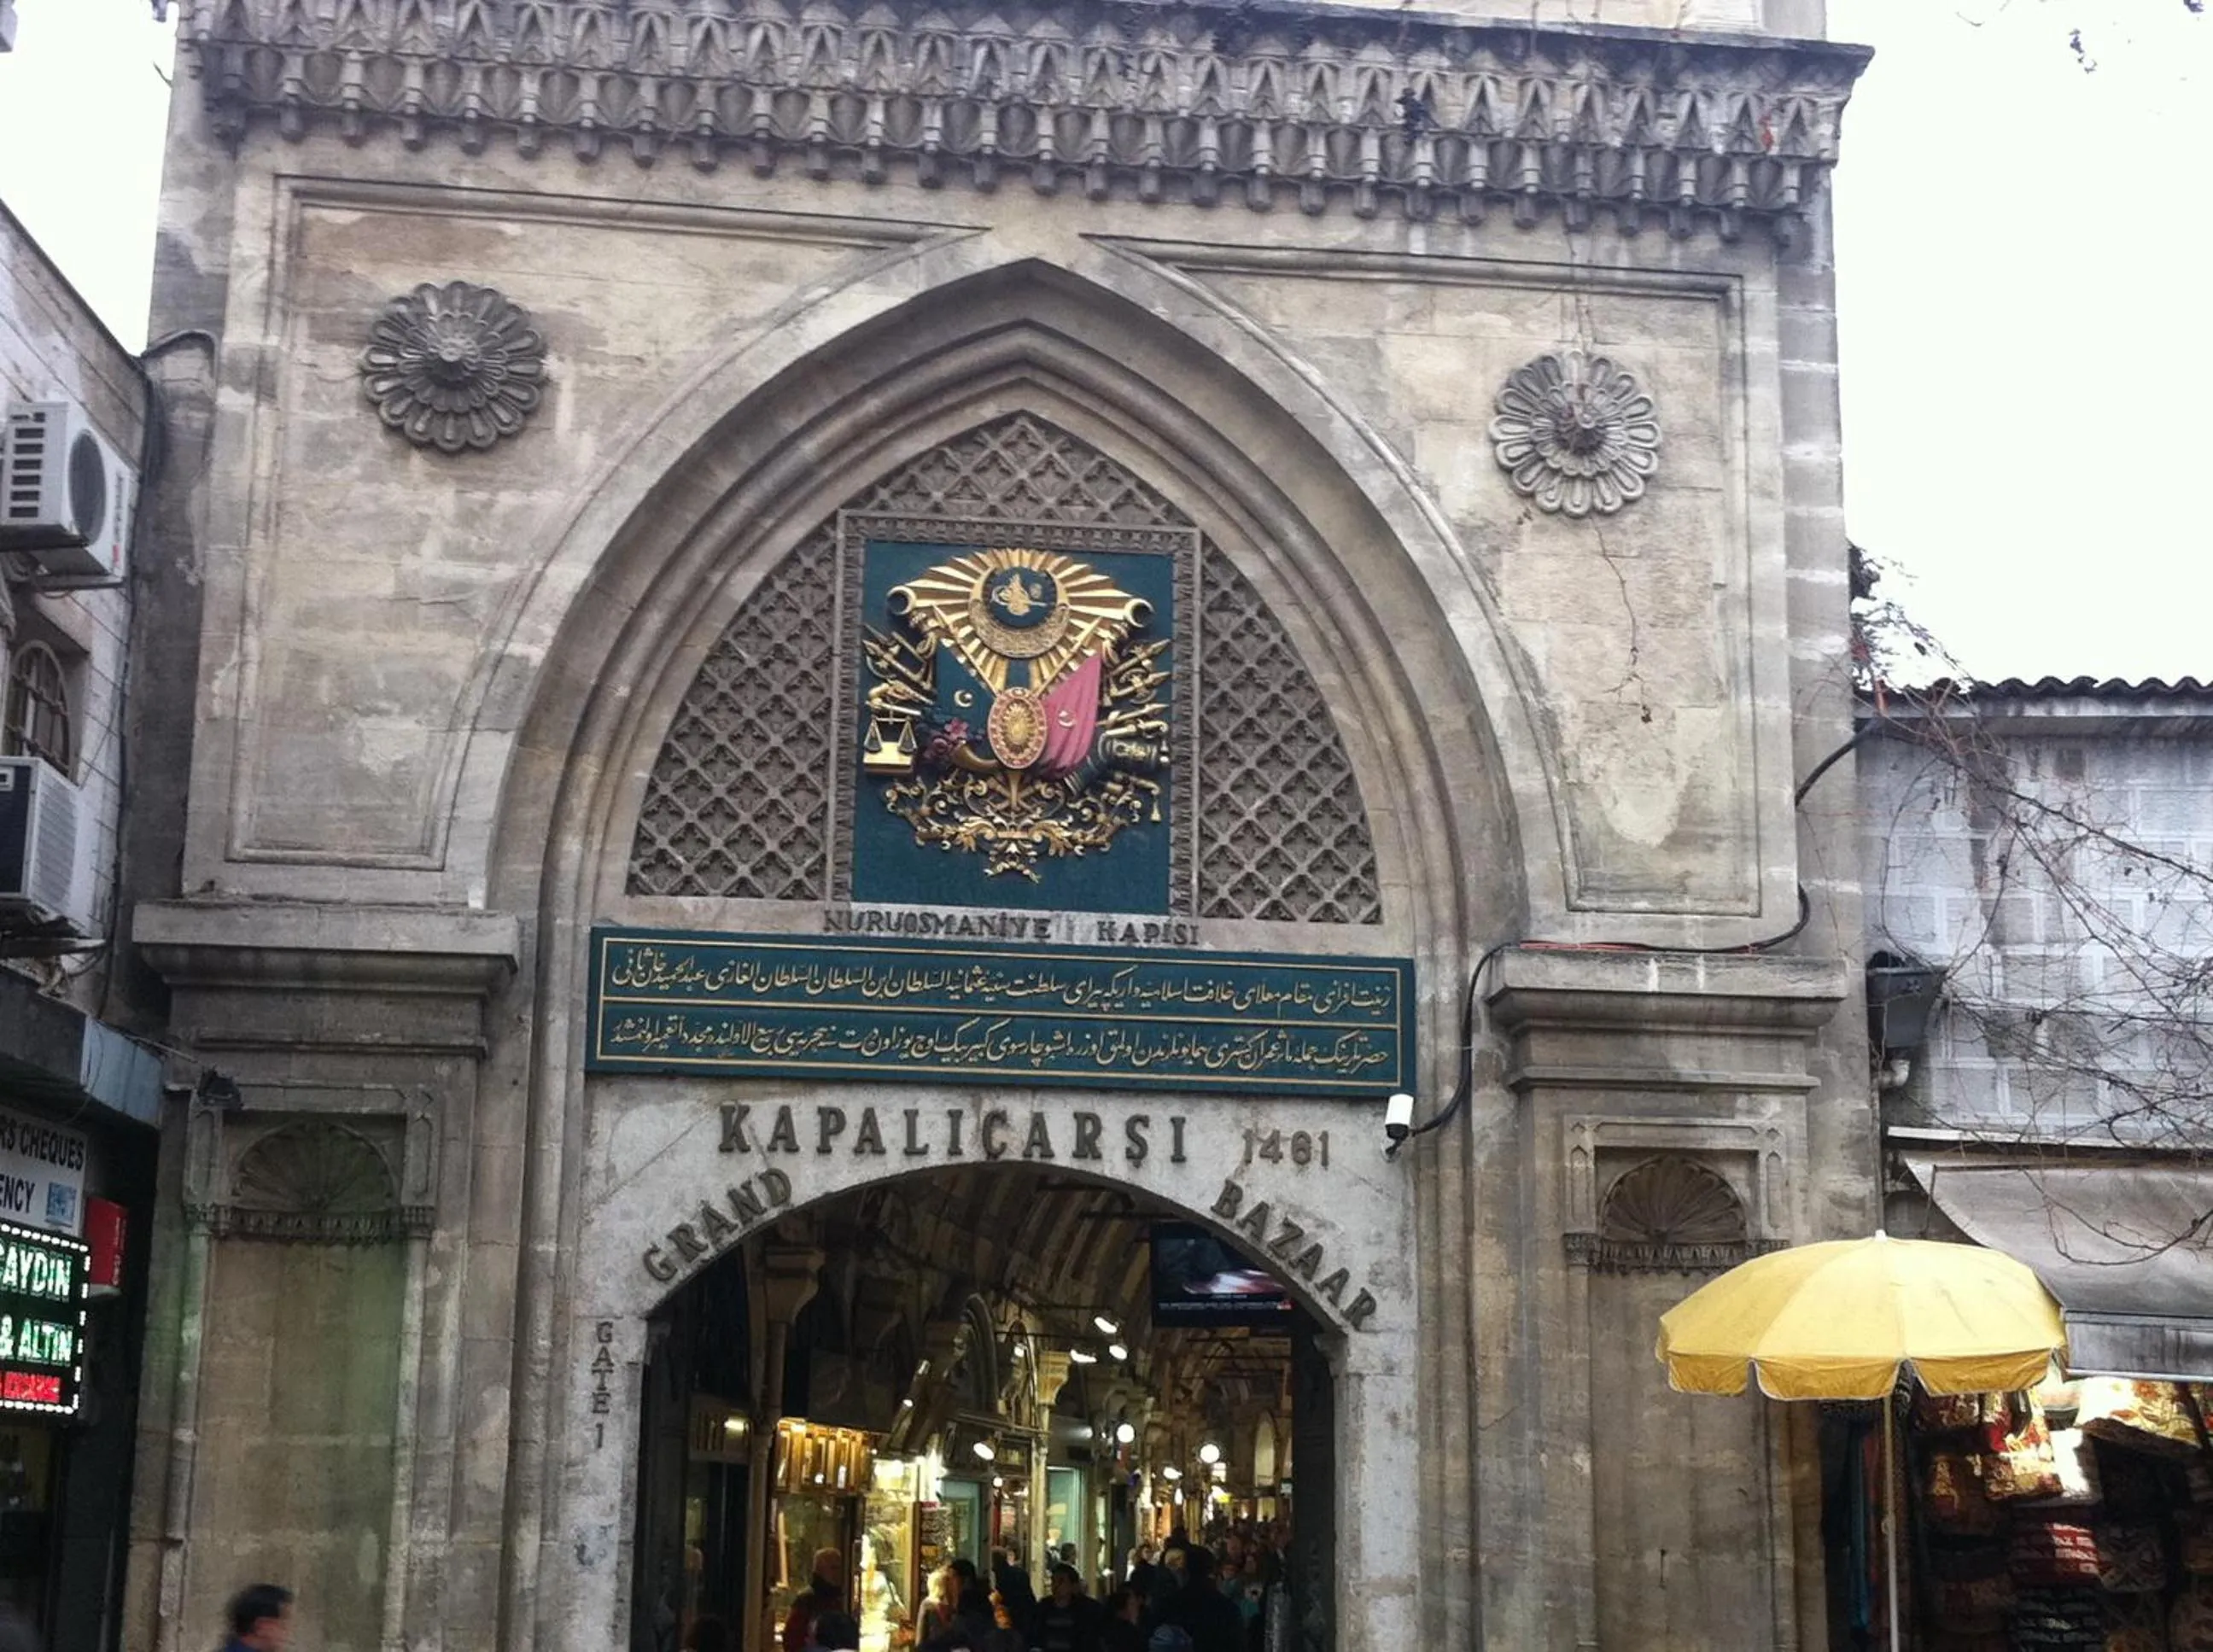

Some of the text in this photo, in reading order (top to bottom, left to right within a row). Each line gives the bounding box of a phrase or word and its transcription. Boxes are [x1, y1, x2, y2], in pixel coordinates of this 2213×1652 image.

[20, 1124, 84, 1171] CHEQUES
[718, 1103, 1188, 1168] KAPALIÇARŞI
[1242, 1129, 1330, 1167] 1461
[642, 1167, 1377, 1331] GRAND BAZAAR
[592, 1321, 615, 1415] GATE
